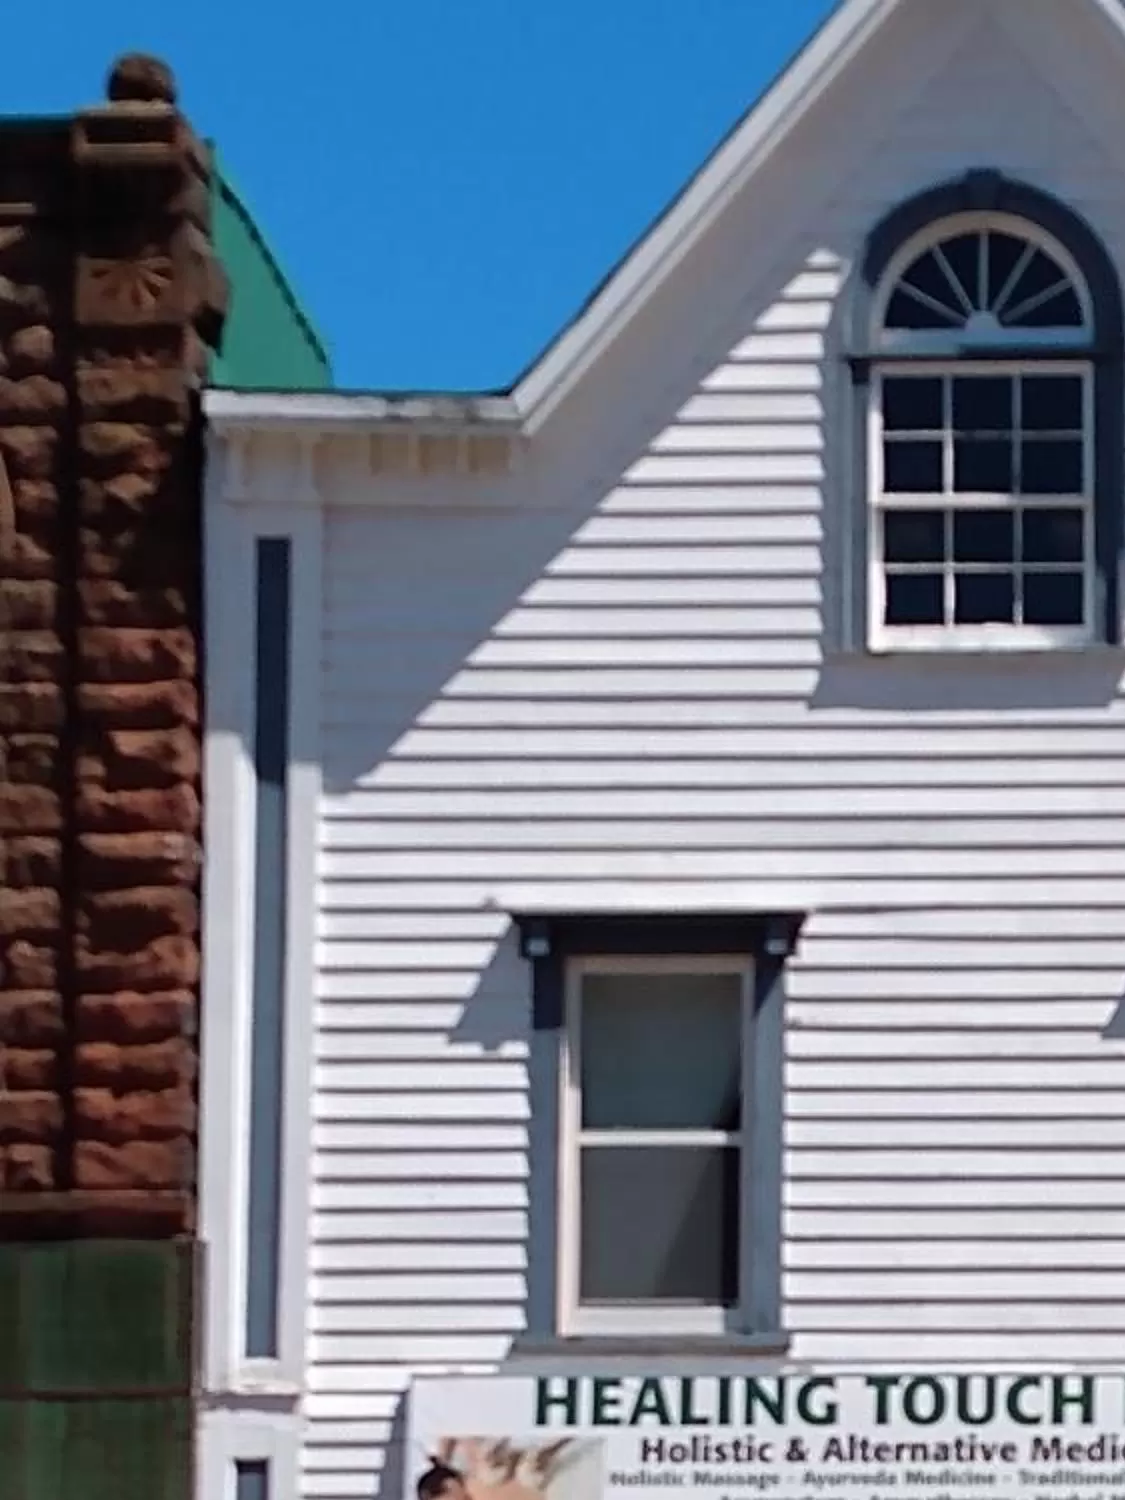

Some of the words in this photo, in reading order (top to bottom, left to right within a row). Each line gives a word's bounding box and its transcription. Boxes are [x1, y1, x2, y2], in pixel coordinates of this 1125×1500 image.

[534, 1376, 838, 1427] HEALING
[863, 1376, 1095, 1426] TOUCH
[640, 1434, 773, 1463] Holistic
[785, 1437, 808, 1463] &
[822, 1434, 1018, 1463] Alternative
[609, 1469, 685, 1487] Holistic
[693, 1470, 781, 1490] Massage
[802, 1469, 898, 1489] Ayurveda
[905, 1469, 997, 1486] Medicine
